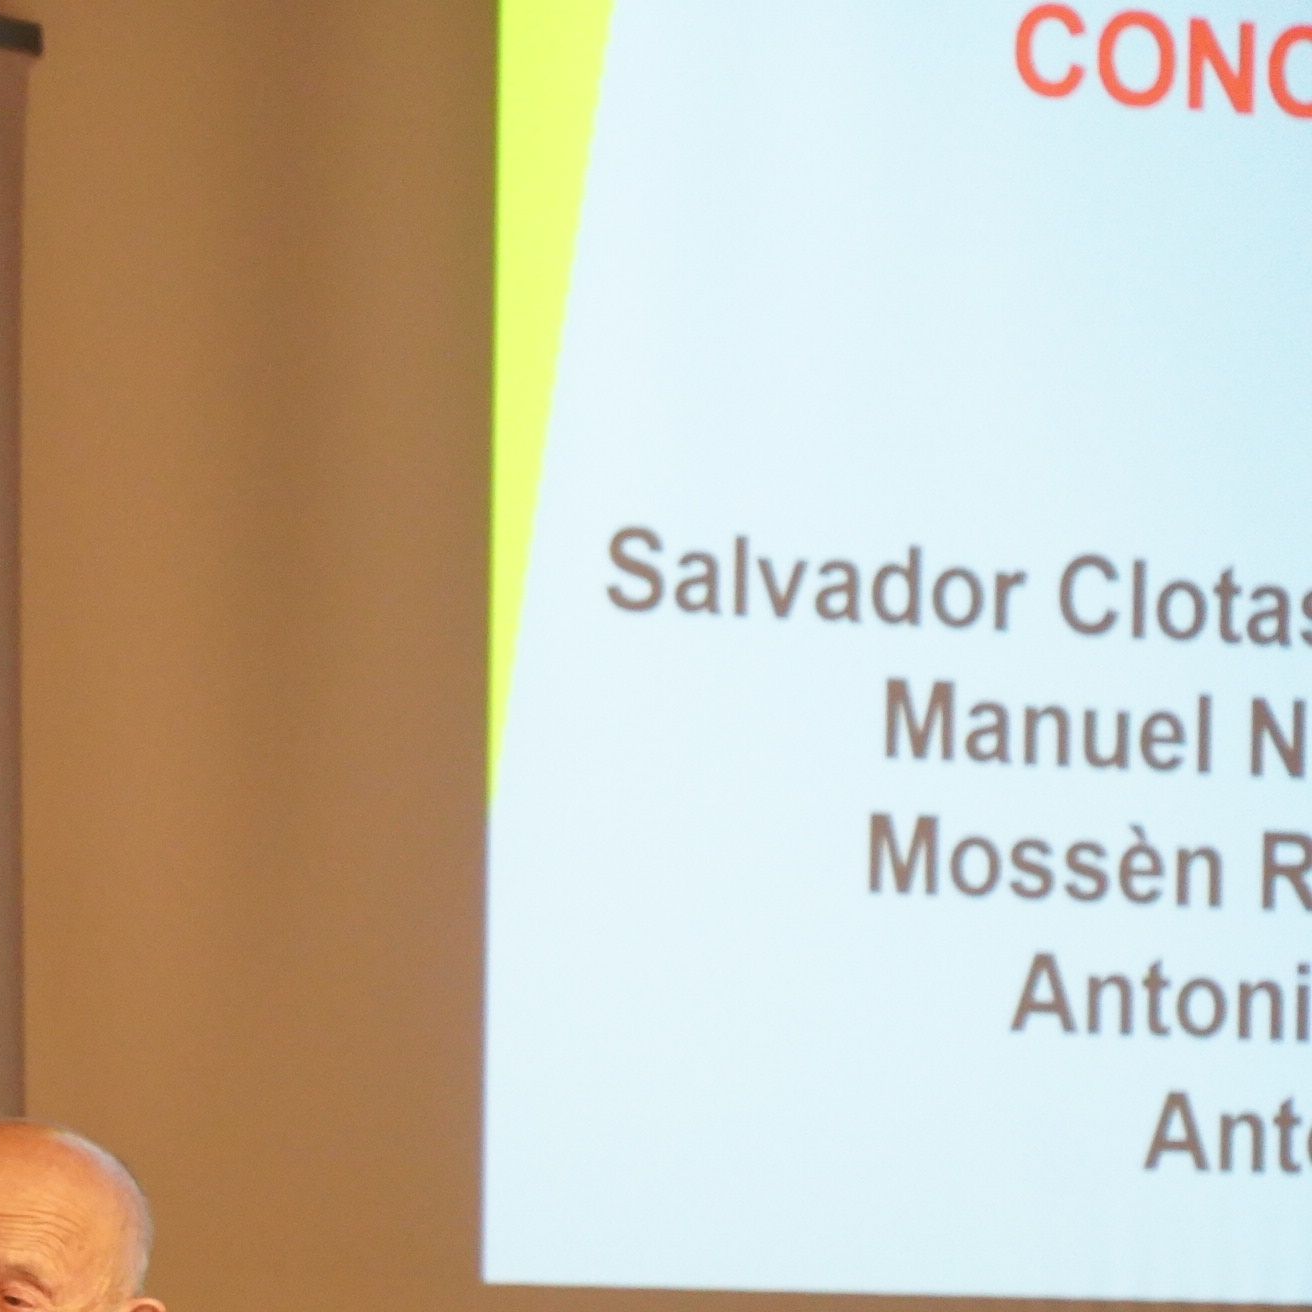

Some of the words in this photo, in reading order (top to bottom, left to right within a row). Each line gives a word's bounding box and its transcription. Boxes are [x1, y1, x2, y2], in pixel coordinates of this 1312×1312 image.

[606, 525, 1028, 632] Salvador
[1058, 553, 1312, 649] Clota
[885, 677, 1213, 775] Manuel
[868, 811, 1223, 909] Mossèn
[1010, 951, 1311, 1043] Antoni
[1143, 1090, 1312, 1176] Ant
